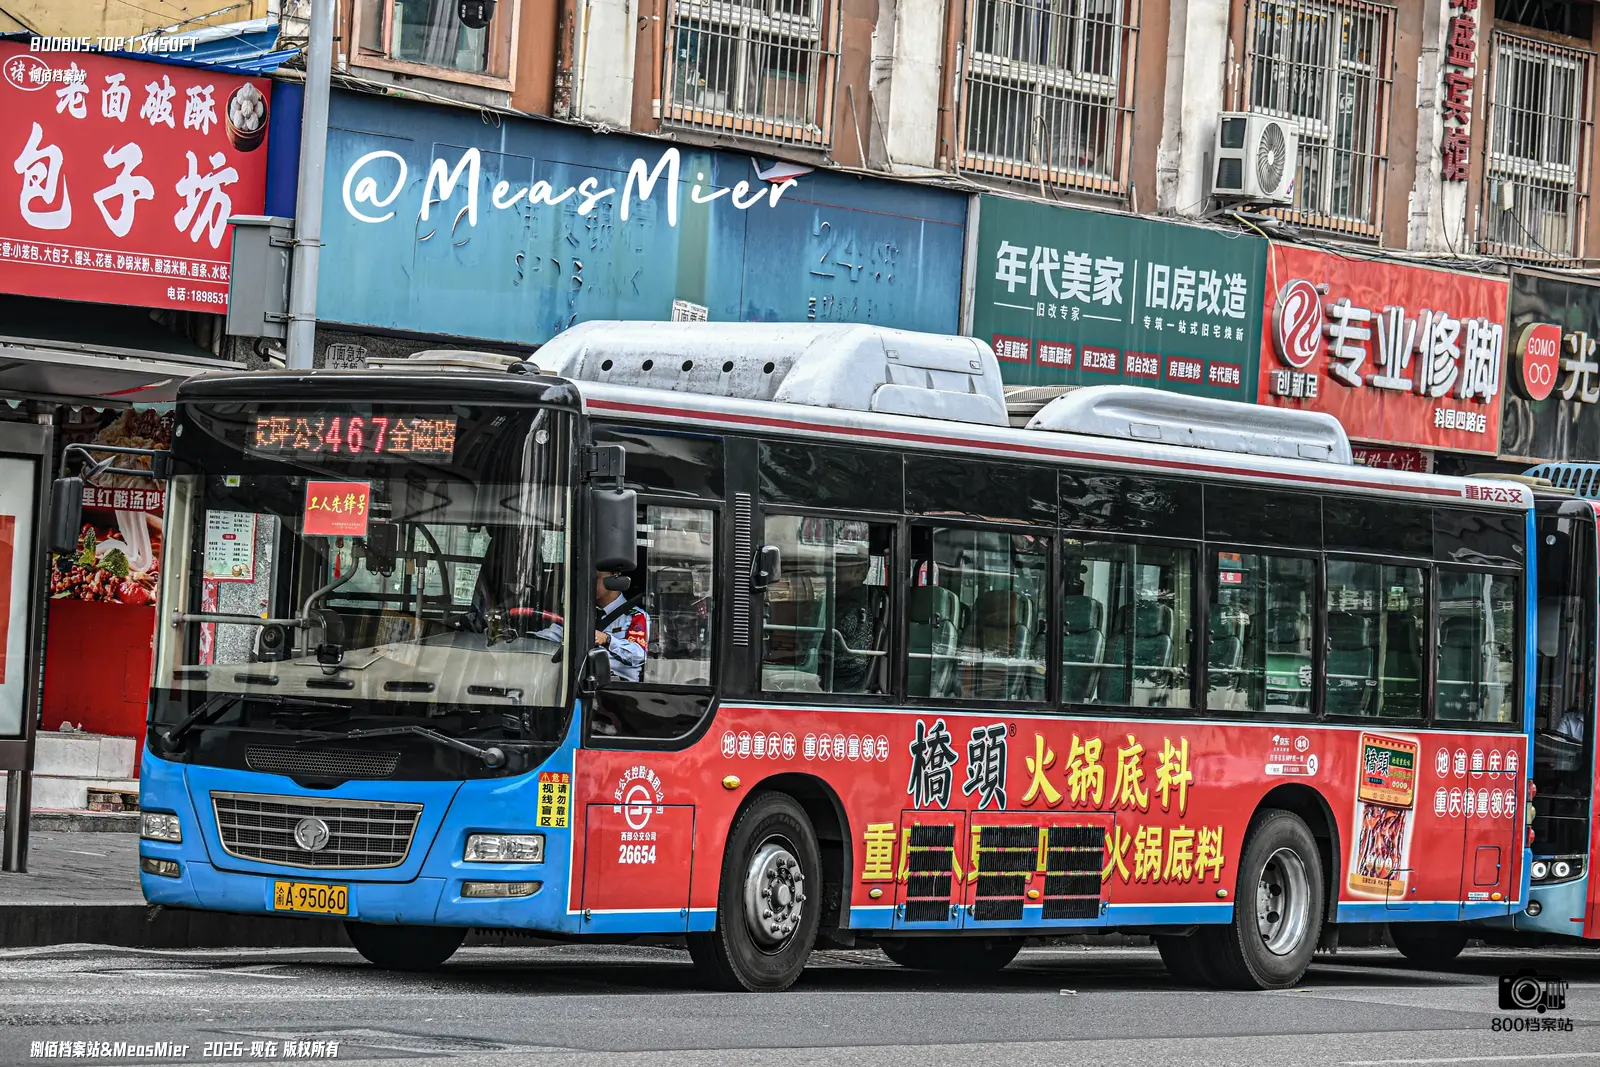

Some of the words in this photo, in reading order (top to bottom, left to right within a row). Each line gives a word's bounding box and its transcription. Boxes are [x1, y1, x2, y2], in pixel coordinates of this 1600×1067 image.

[56, 61, 218, 136] 老面破酥
[13, 121, 239, 249] 包子坊
[0, 241, 230, 280] 营:小笼包、大包子、馒头、花卷、砂锅米粉、酸汤米粉、面条、水饺、
[995, 240, 1124, 306] 年代美家
[1145, 261, 1247, 319] 旧房改造
[1036, 302, 1080, 322] 旧改专家
[1143, 315, 1244, 342] 专筑一站式旧宅焕新
[996, 339, 1029, 361] 全屋翻新
[1040, 344, 1073, 366] 墙面翻新
[1083, 349, 1117, 371] 厨卫改造
[1126, 356, 1159, 376] 阳台改造
[1169, 360, 1202, 380] 房屋维修
[1209, 365, 1241, 385] 年代厨电
[1325, 298, 1503, 405] 专业修脚
[1528, 337, 1556, 357] GOMO
[1563, 331, 1600, 403] 光
[1275, 369, 1318, 399] 创新足
[325, 416, 389, 453] 467
[1434, 407, 1487, 434] 科园四路店
[81, 487, 166, 511] 里红酸汤砂
[308, 493, 366, 516] 工人先锋号
[1464, 484, 1524, 504] 重庆公交
[722, 732, 796, 759] 地道重庆味
[803, 733, 890, 762] 重庆销量领先
[551, 773, 569, 783] 危险
[907, 718, 1007, 810] 橋頭
[1021, 731, 1195, 814] 火锅底料
[1436, 750, 1518, 779] 地道重庆味
[540, 783, 554, 826] 视线盲区
[556, 784, 567, 827] 请勿靠近
[1435, 788, 1516, 818] 重庆销量领先
[620, 831, 657, 841] 西部公交公司
[618, 844, 656, 864] 26654
